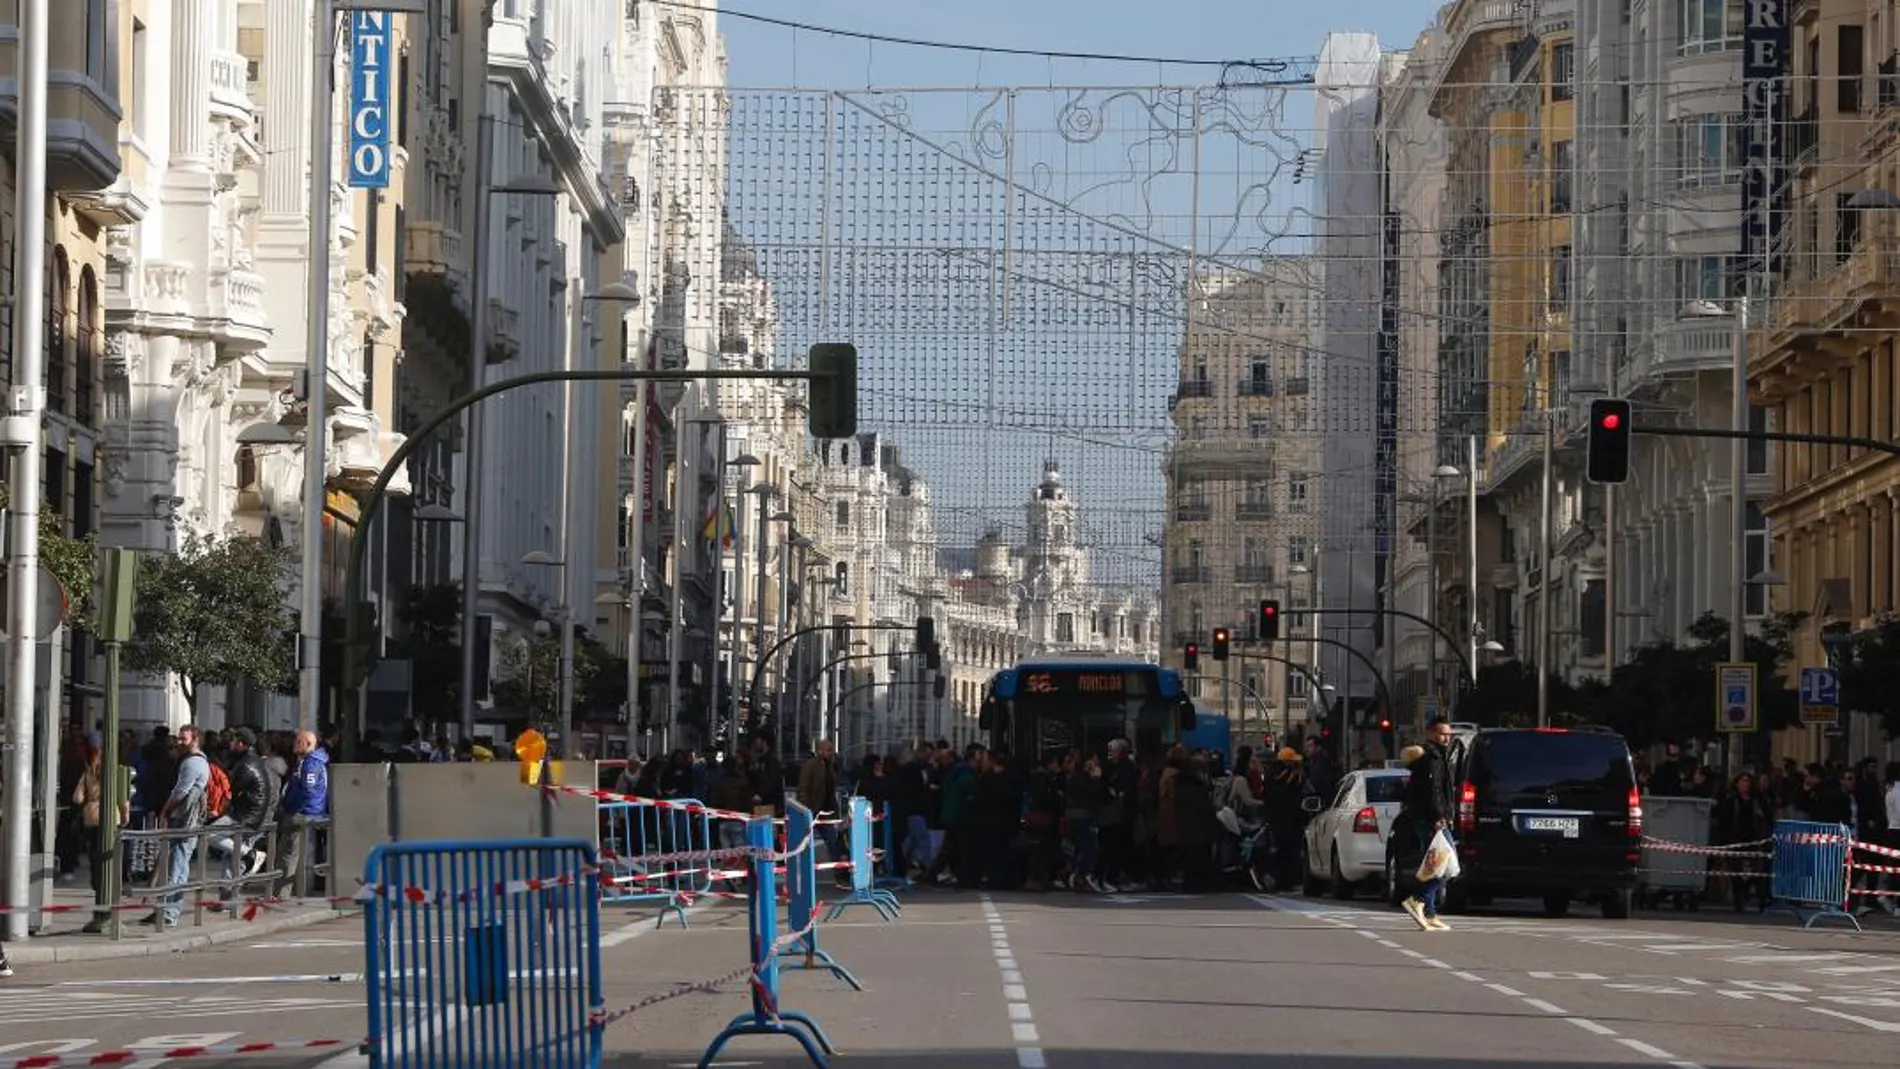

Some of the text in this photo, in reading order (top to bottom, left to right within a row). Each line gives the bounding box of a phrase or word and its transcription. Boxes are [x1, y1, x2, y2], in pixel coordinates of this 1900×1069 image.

[355, 11, 384, 175] NTICO
[1808, 672, 1834, 702] P
[306, 773, 317, 785] 5
